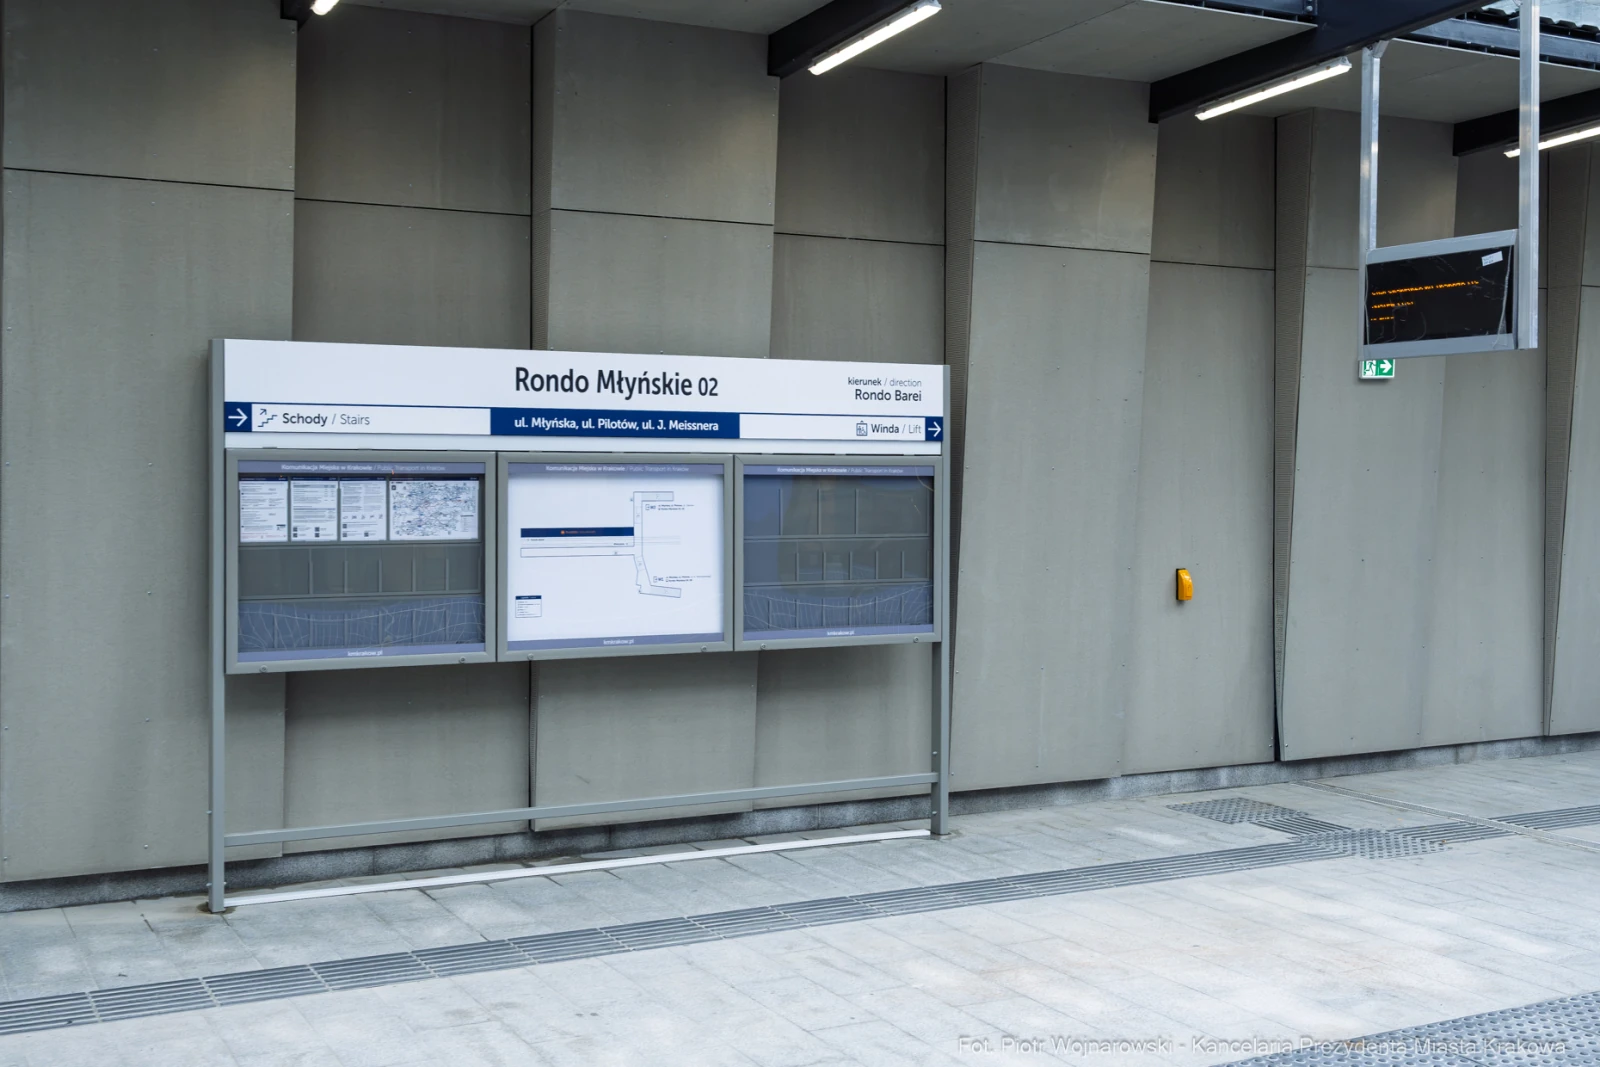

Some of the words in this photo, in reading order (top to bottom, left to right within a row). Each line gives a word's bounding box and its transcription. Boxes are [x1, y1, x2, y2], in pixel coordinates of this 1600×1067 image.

[515, 367, 590, 393] Rondo
[597, 369, 693, 400] Młyńskie
[698, 377, 719, 396] 02
[847, 377, 882, 386] kierunek
[889, 378, 922, 387] direction
[855, 389, 892, 400] Rondo
[894, 390, 922, 401] Barei
[282, 413, 328, 427] Schody
[331, 413, 337, 425] /
[340, 414, 371, 425] Stairs
[514, 417, 529, 428] ul.
[531, 417, 579, 431] Młyńska,
[581, 418, 595, 429] ul.
[597, 418, 640, 431] Pilotów,
[642, 419, 655, 430] ul.
[657, 420, 666, 431] J.
[668, 420, 719, 431] Meissnera
[871, 423, 900, 433] Winda
[902, 424, 906, 434] /
[908, 424, 922, 434] Lift
